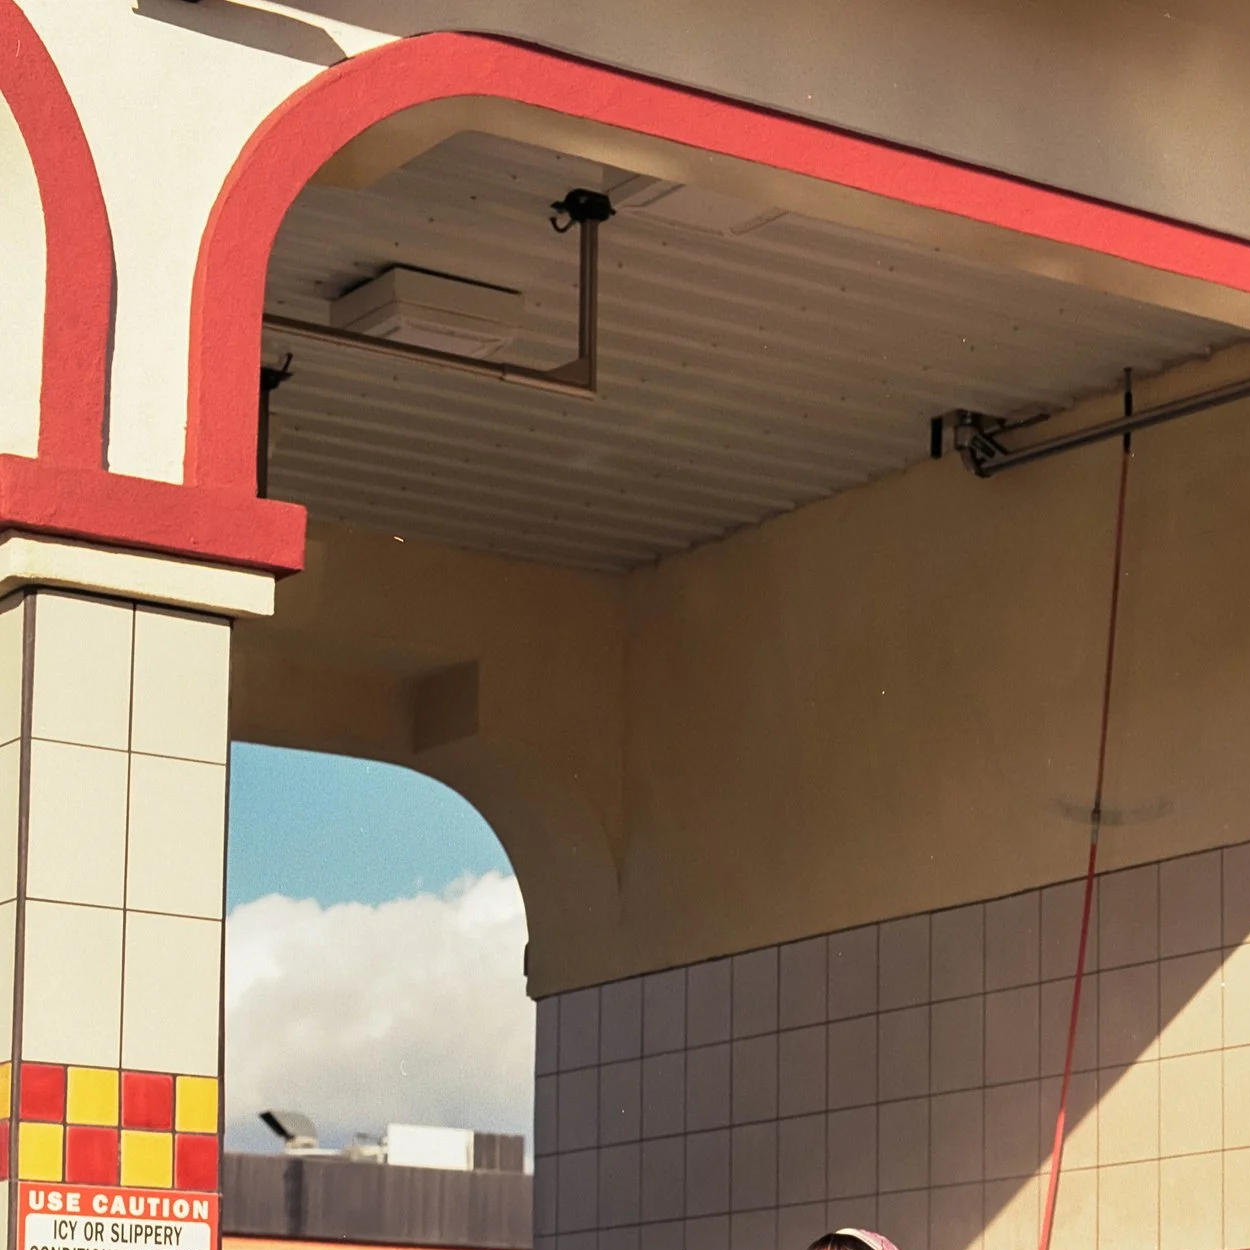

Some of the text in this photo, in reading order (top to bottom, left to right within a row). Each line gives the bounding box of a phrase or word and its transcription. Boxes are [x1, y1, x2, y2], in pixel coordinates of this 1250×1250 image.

[28, 1189, 209, 1220] USE CAUTION
[53, 1219, 183, 1246] ICY OR SLIPPERY
